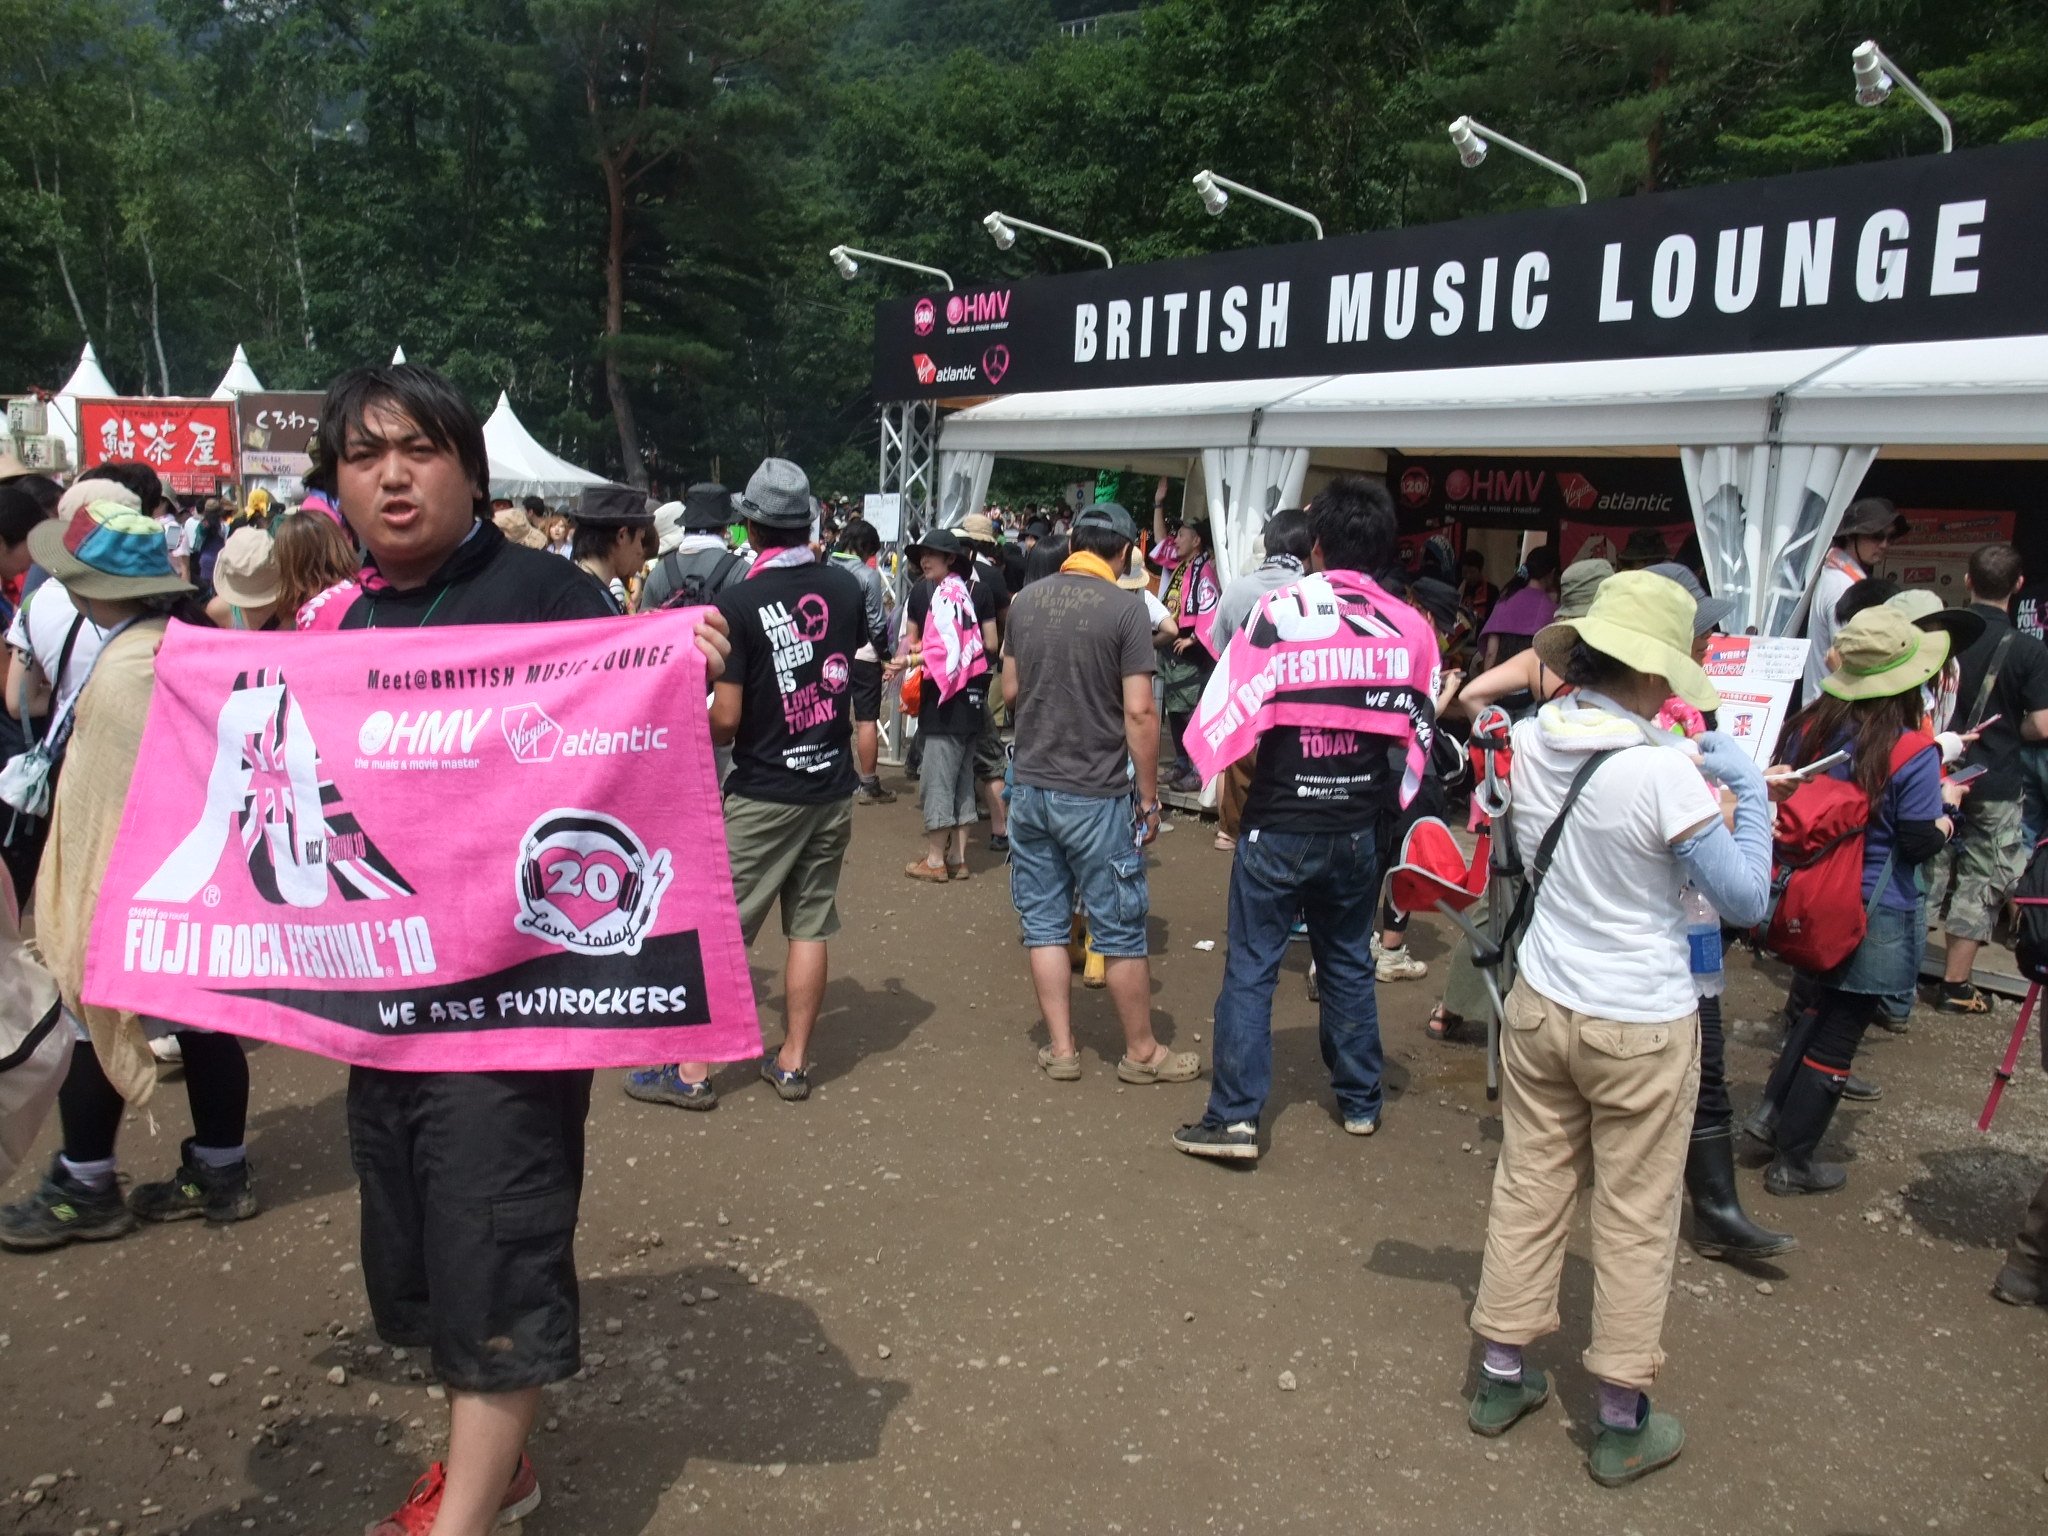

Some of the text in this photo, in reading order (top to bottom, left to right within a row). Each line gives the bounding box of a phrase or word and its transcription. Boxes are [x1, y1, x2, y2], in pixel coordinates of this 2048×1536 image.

[1074, 199, 1987, 363] BRITISH MUSIC LOUNGE
[936, 364, 977, 383] atlantic
[1598, 491, 1673, 512] atlantic
[1060, 584, 1106, 608] ROCK
[2017, 598, 2038, 615] ALL
[758, 600, 793, 630] ALL
[2016, 613, 2038, 629] YOU
[765, 620, 800, 651] YOU
[367, 645, 674, 689] Meet@BRITISH MUSIC LOUNGE
[772, 640, 814, 673] NEED
[776, 669, 797, 694] IS
[781, 681, 820, 715] LOVE
[1365, 690, 1391, 708] WE
[784, 697, 838, 735] TODAY.
[511, 711, 553, 757] Virgin
[562, 723, 669, 757] atlantic
[354, 758, 369, 769] the
[371, 757, 399, 770] music
[409, 757, 439, 770] movie
[441, 757, 480, 770] master
[305, 839, 324, 865] ROCK
[546, 859, 621, 903] 20
[522, 910, 637, 947] Love today
[123, 917, 202, 976] FUJI
[207, 922, 289, 979] ROCK
[378, 985, 687, 1029] WE ARE FUJIROCKERS
